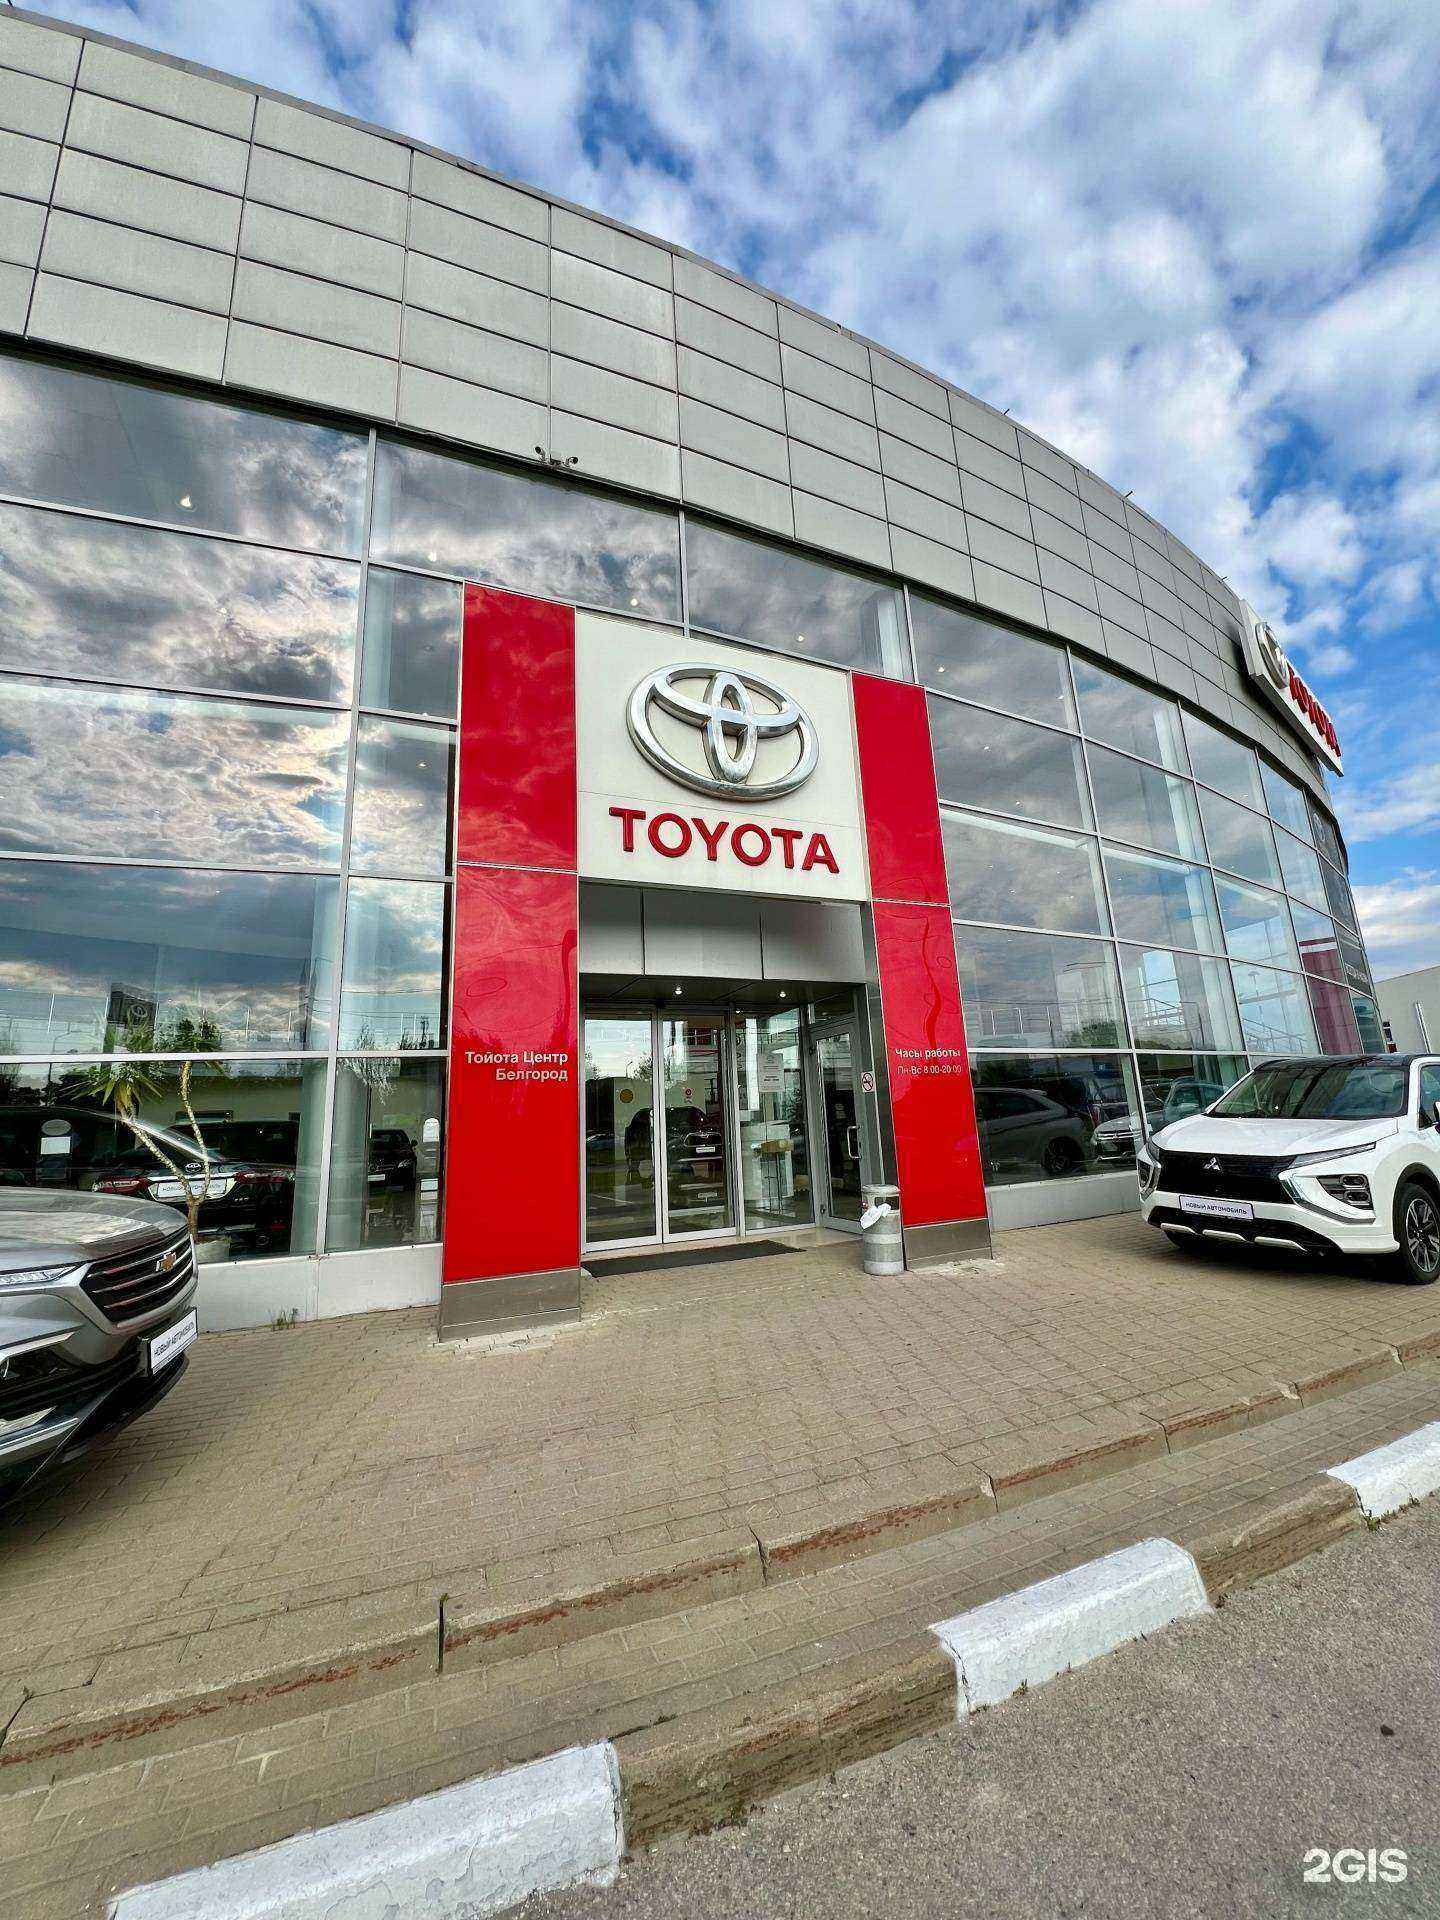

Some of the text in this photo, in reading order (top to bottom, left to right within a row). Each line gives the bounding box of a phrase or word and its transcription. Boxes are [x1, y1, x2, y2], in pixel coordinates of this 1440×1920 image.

[608, 806, 840, 874] TOYOTA
[465, 1051, 568, 1065] Тойота Центр
[895, 1048, 961, 1060] Часы работы
[495, 1068, 569, 1083] Белгород
